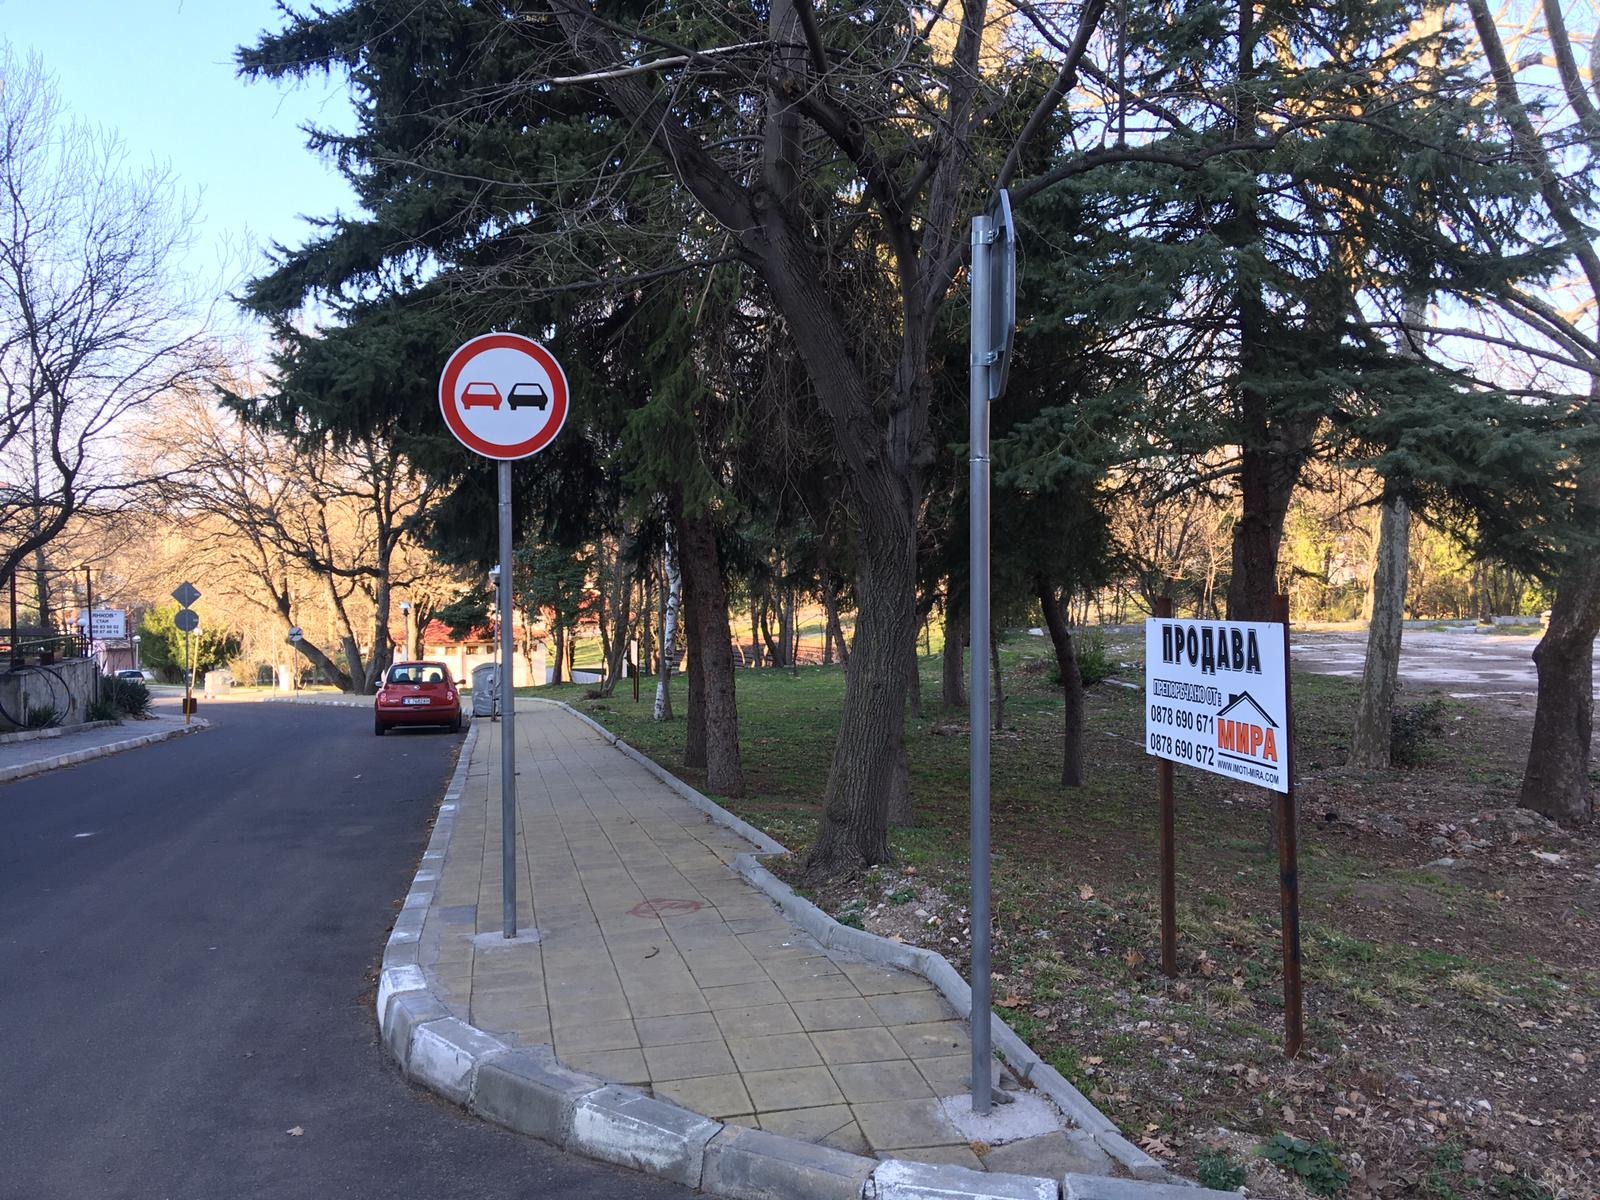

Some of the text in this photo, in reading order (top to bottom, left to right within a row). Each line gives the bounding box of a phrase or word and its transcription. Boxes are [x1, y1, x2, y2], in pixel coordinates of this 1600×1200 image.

[1162, 624, 1262, 675] ПРОДАВА
[1153, 678, 1222, 707] ПРЕПОРЪЧАНО ОТ:
[1151, 705, 1213, 735] 0878 690 671
[1151, 733, 1214, 766] 0878 690 672
[1217, 718, 1278, 762] МИРА
[1217, 760, 1279, 784] WWW.IMOTI-MIRA.COM
